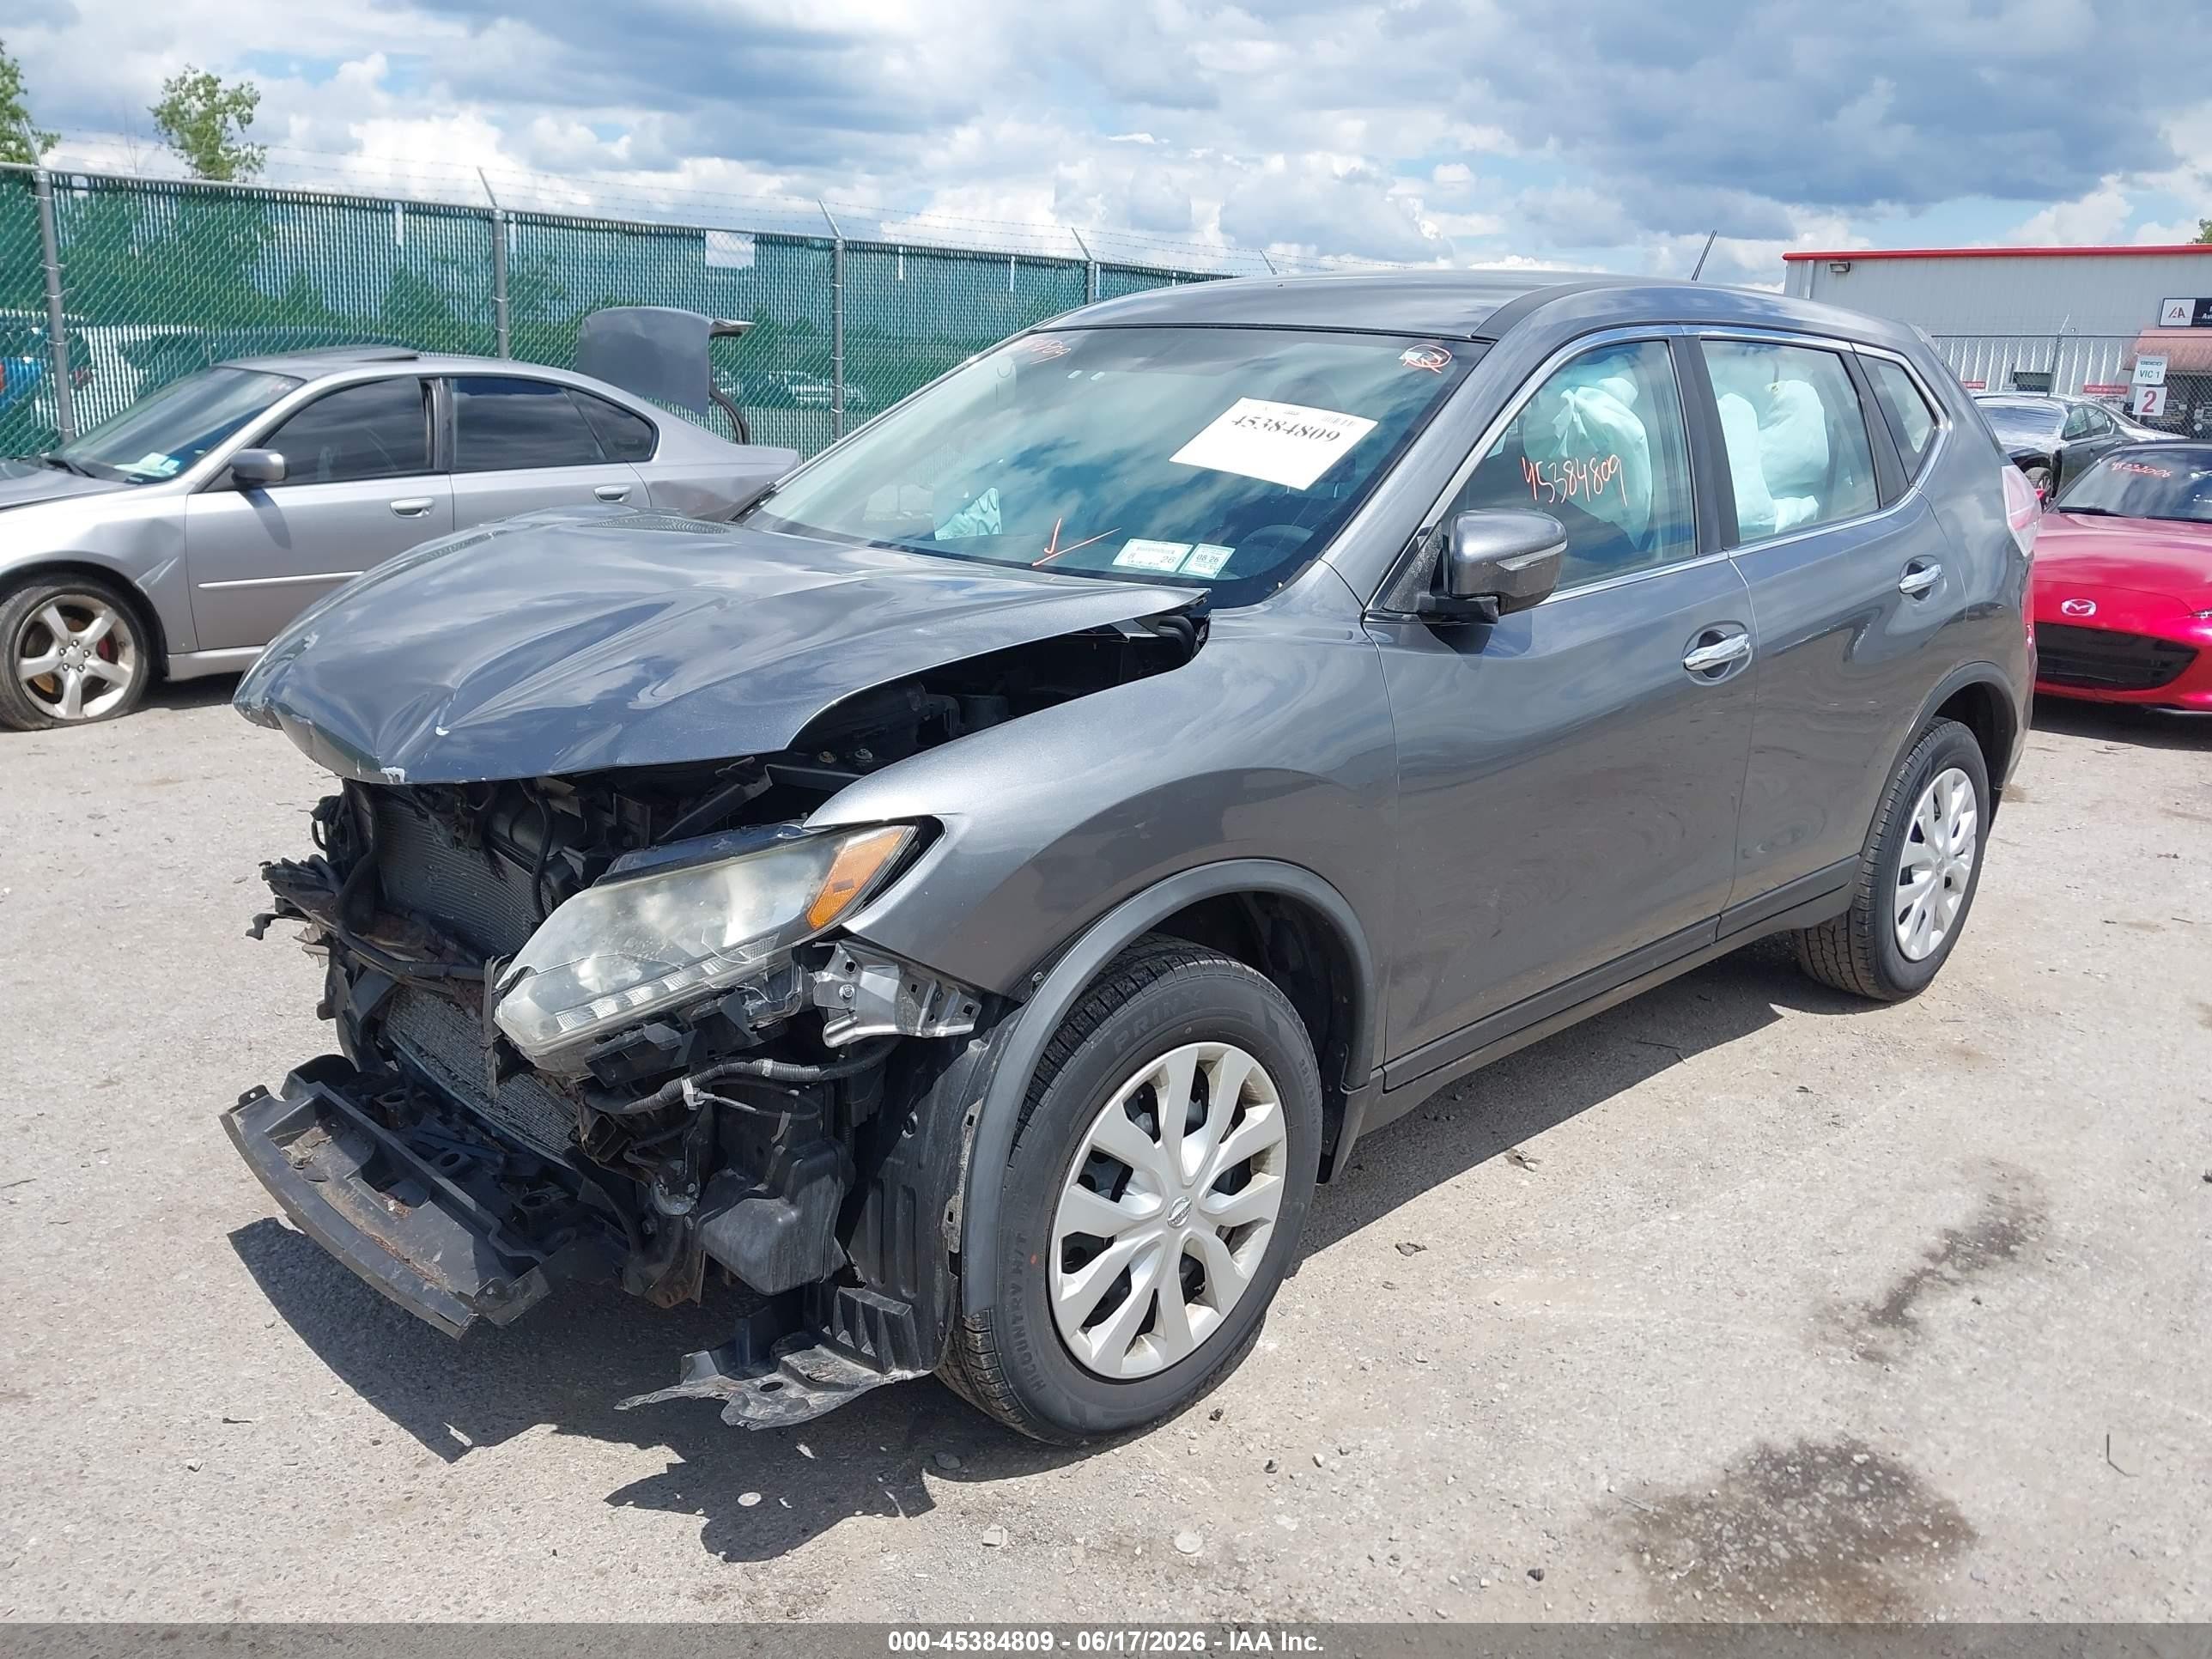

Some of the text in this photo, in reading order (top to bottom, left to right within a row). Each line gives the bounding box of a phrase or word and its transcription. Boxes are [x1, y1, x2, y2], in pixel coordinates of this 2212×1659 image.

[2139, 370, 2160, 379] VIC 1
[2142, 390, 2157, 413] 2
[1231, 416, 1340, 441] 45384809
[1521, 453, 1628, 507] 45384809
